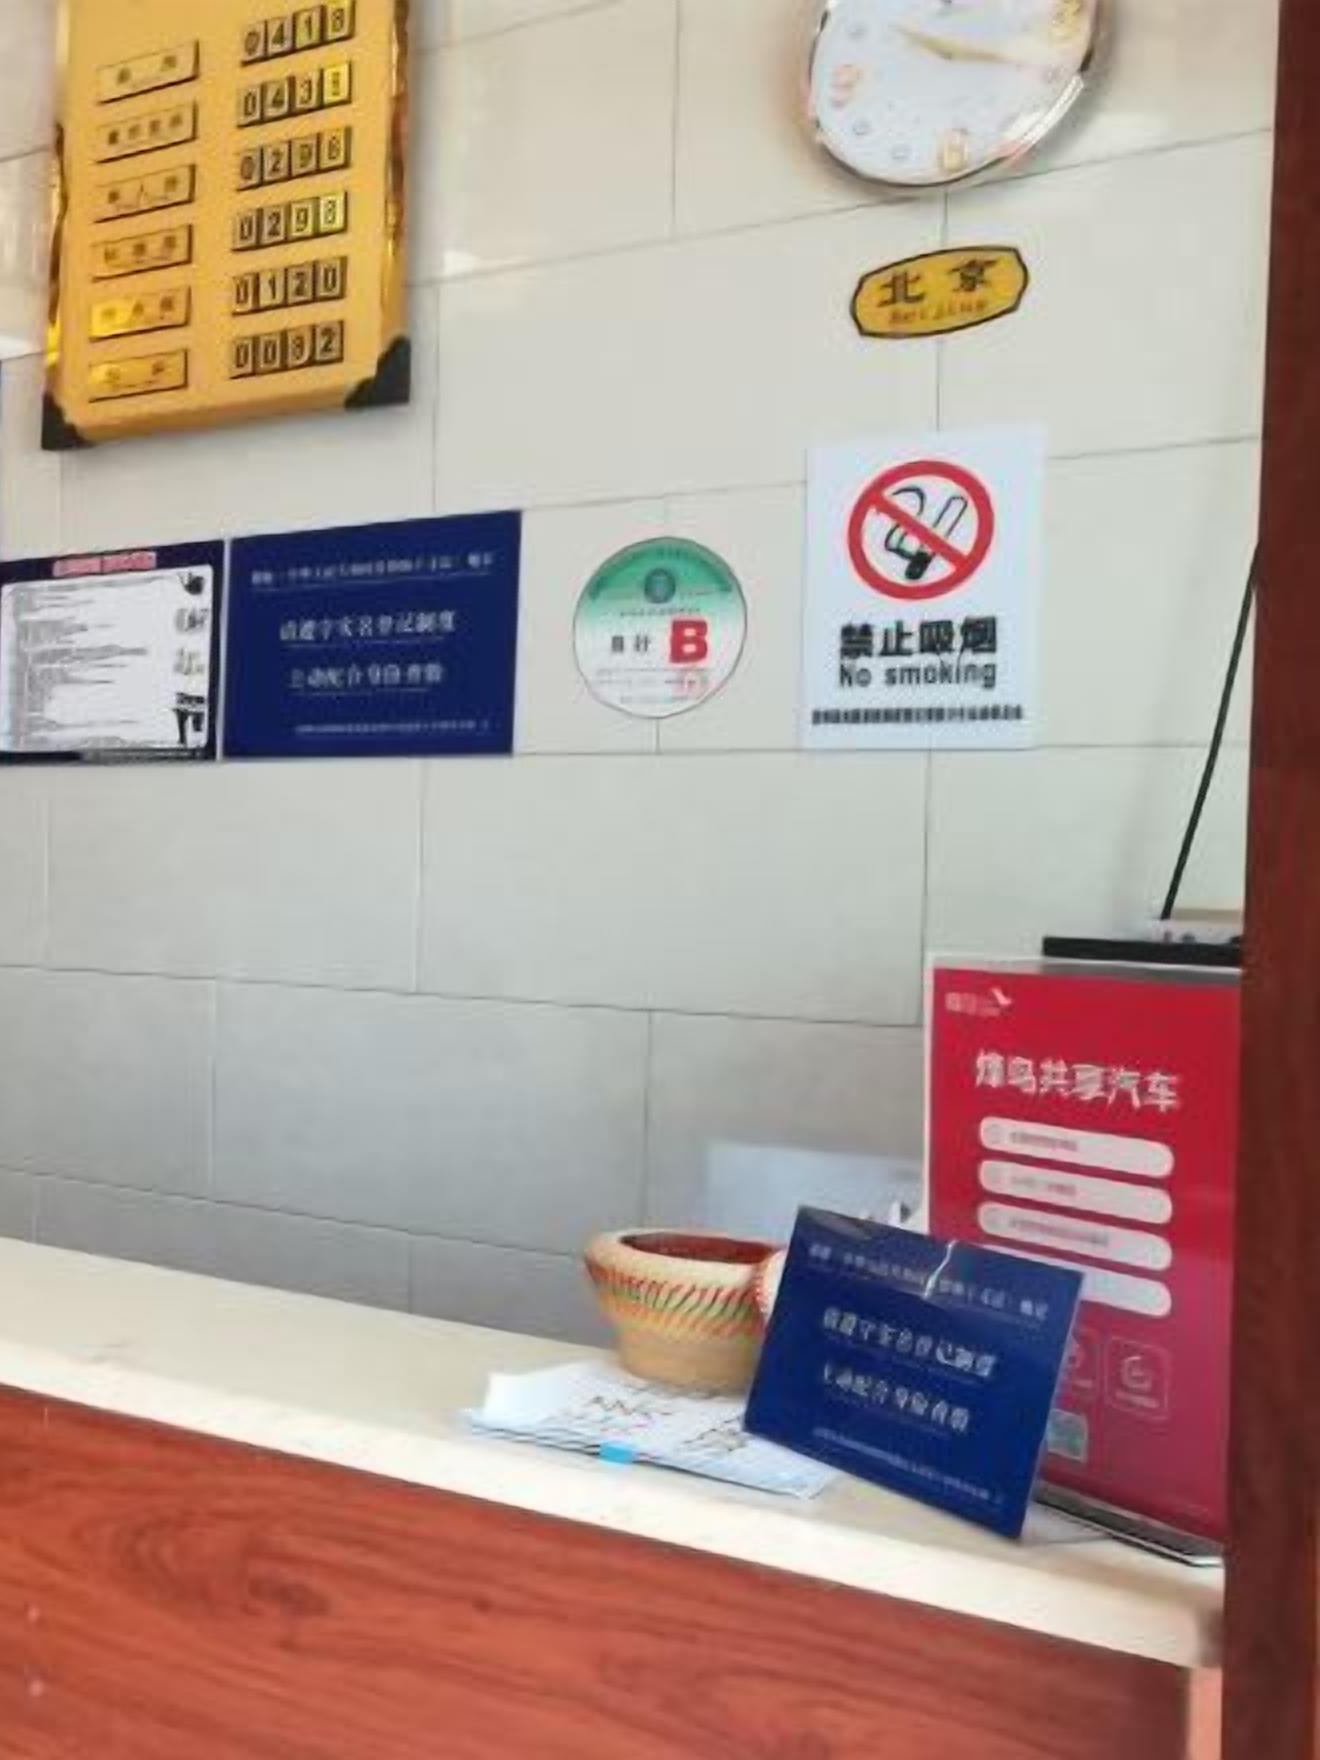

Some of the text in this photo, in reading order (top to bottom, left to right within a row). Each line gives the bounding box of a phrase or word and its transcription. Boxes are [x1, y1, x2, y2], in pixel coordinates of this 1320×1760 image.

[236, 266, 338, 305] 0120
[878, 258, 1002, 307] 北京
[670, 619, 708, 664] B
[840, 616, 997, 660] 禁止吸烟
[839, 662, 997, 691] No smoking
